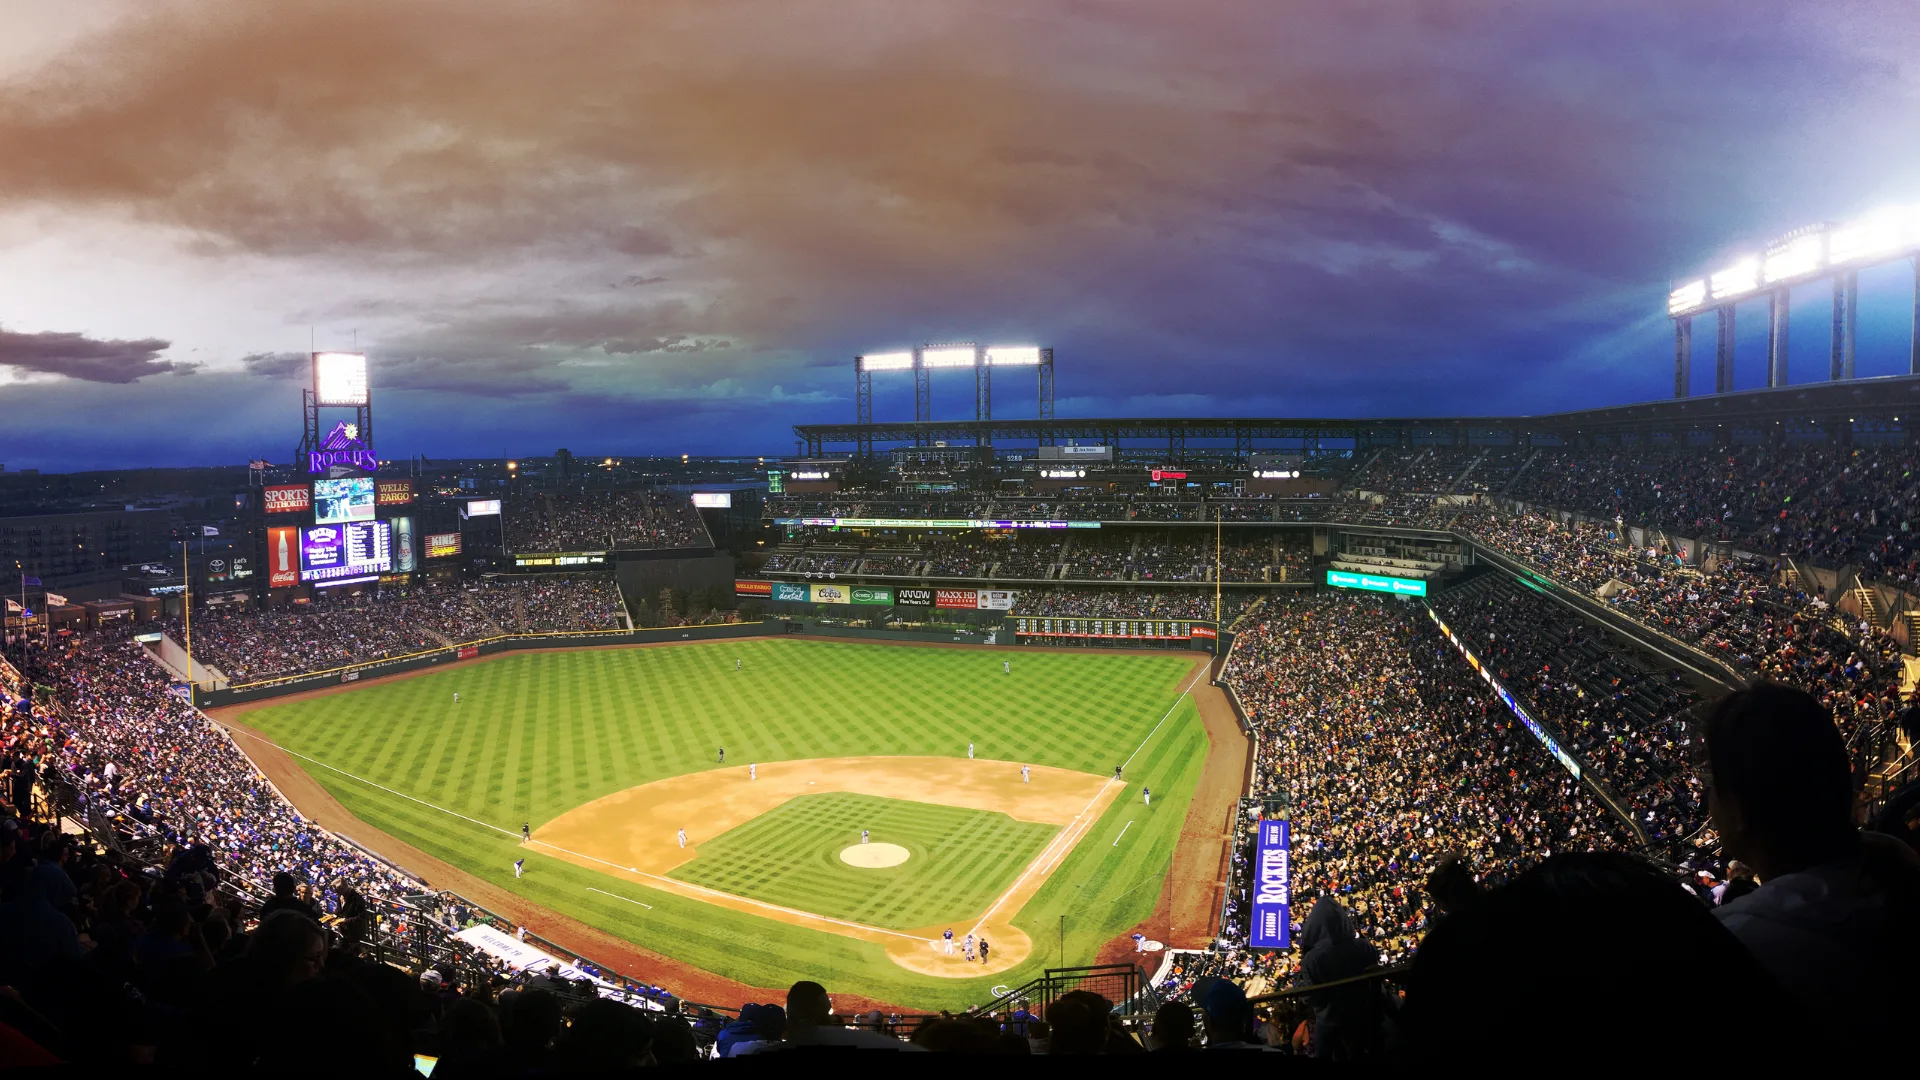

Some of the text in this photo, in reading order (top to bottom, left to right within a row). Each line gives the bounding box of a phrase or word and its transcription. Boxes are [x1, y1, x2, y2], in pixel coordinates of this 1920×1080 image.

[308, 450, 377, 473] ROCKIES
[379, 483, 409, 493] WELLS
[264, 488, 309, 502] SPORTS
[380, 492, 410, 502] FARGO
[431, 533, 455, 547] KING
[234, 569, 253, 577] Places
[754, 583, 772, 591] FARGO
[818, 588, 842, 598] Coors
[899, 590, 930, 599] ARROW
[937, 590, 977, 600] MAXX HD
[1257, 849, 1288, 905] ROCKIES
[1265, 912, 1277, 937] COLORADO
[481, 934, 523, 957] WELCOME TO
